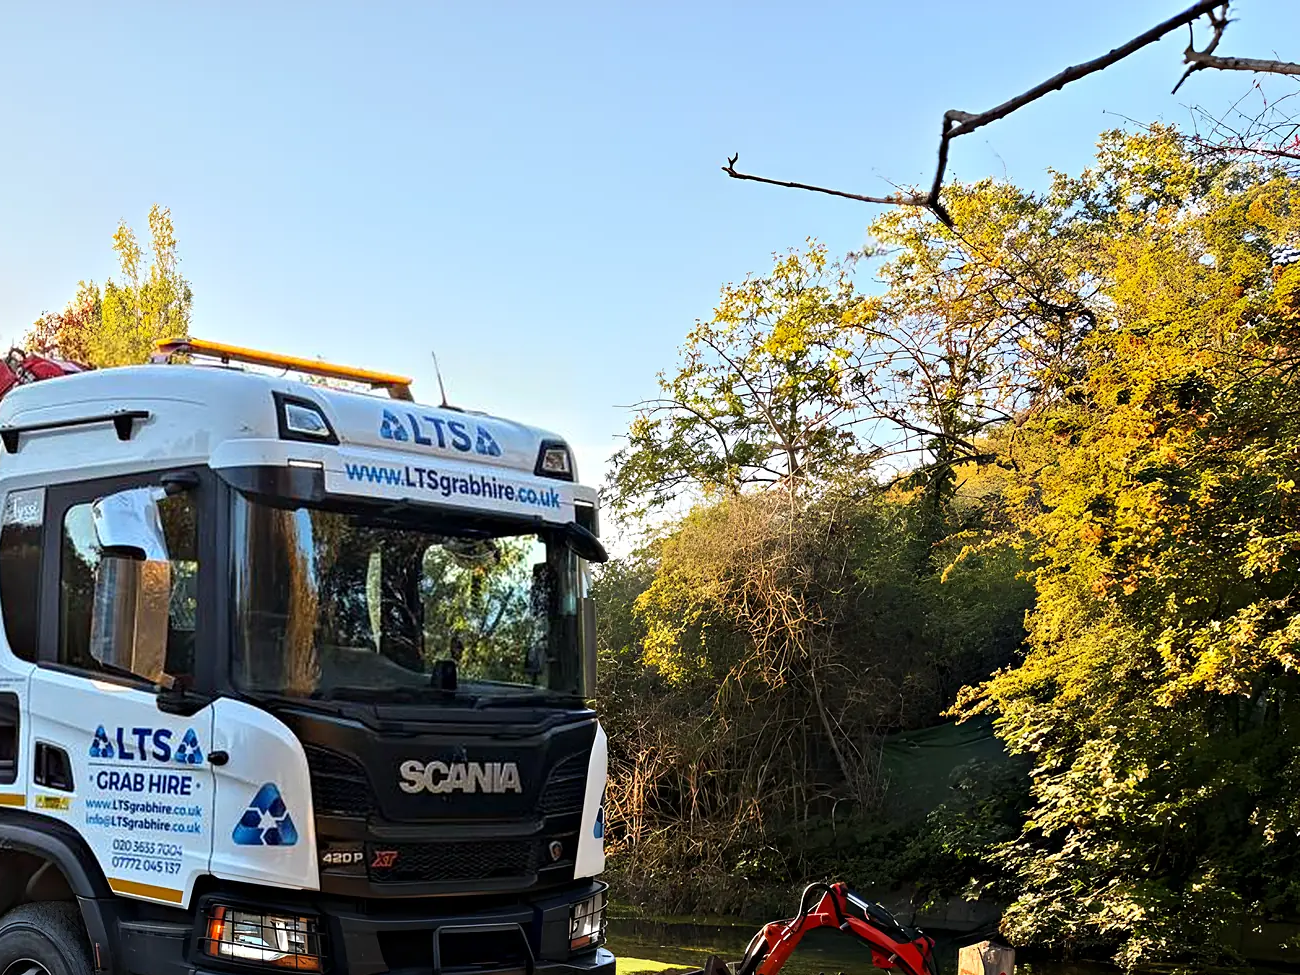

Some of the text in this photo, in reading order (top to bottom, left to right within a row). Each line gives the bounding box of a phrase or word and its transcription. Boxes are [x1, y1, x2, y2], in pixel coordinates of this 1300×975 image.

[345, 463, 562, 510] www.LTSgrabhire.co.uk
[96, 771, 193, 796] GRAB HIRE
[399, 760, 523, 794] SCANIA
[85, 799, 202, 818] www.LTSgrabhire.co.uk
[85, 813, 201, 833] info@LTSgrabhire.co.uk
[112, 839, 132, 851] 020
[111, 856, 142, 871] 07772
